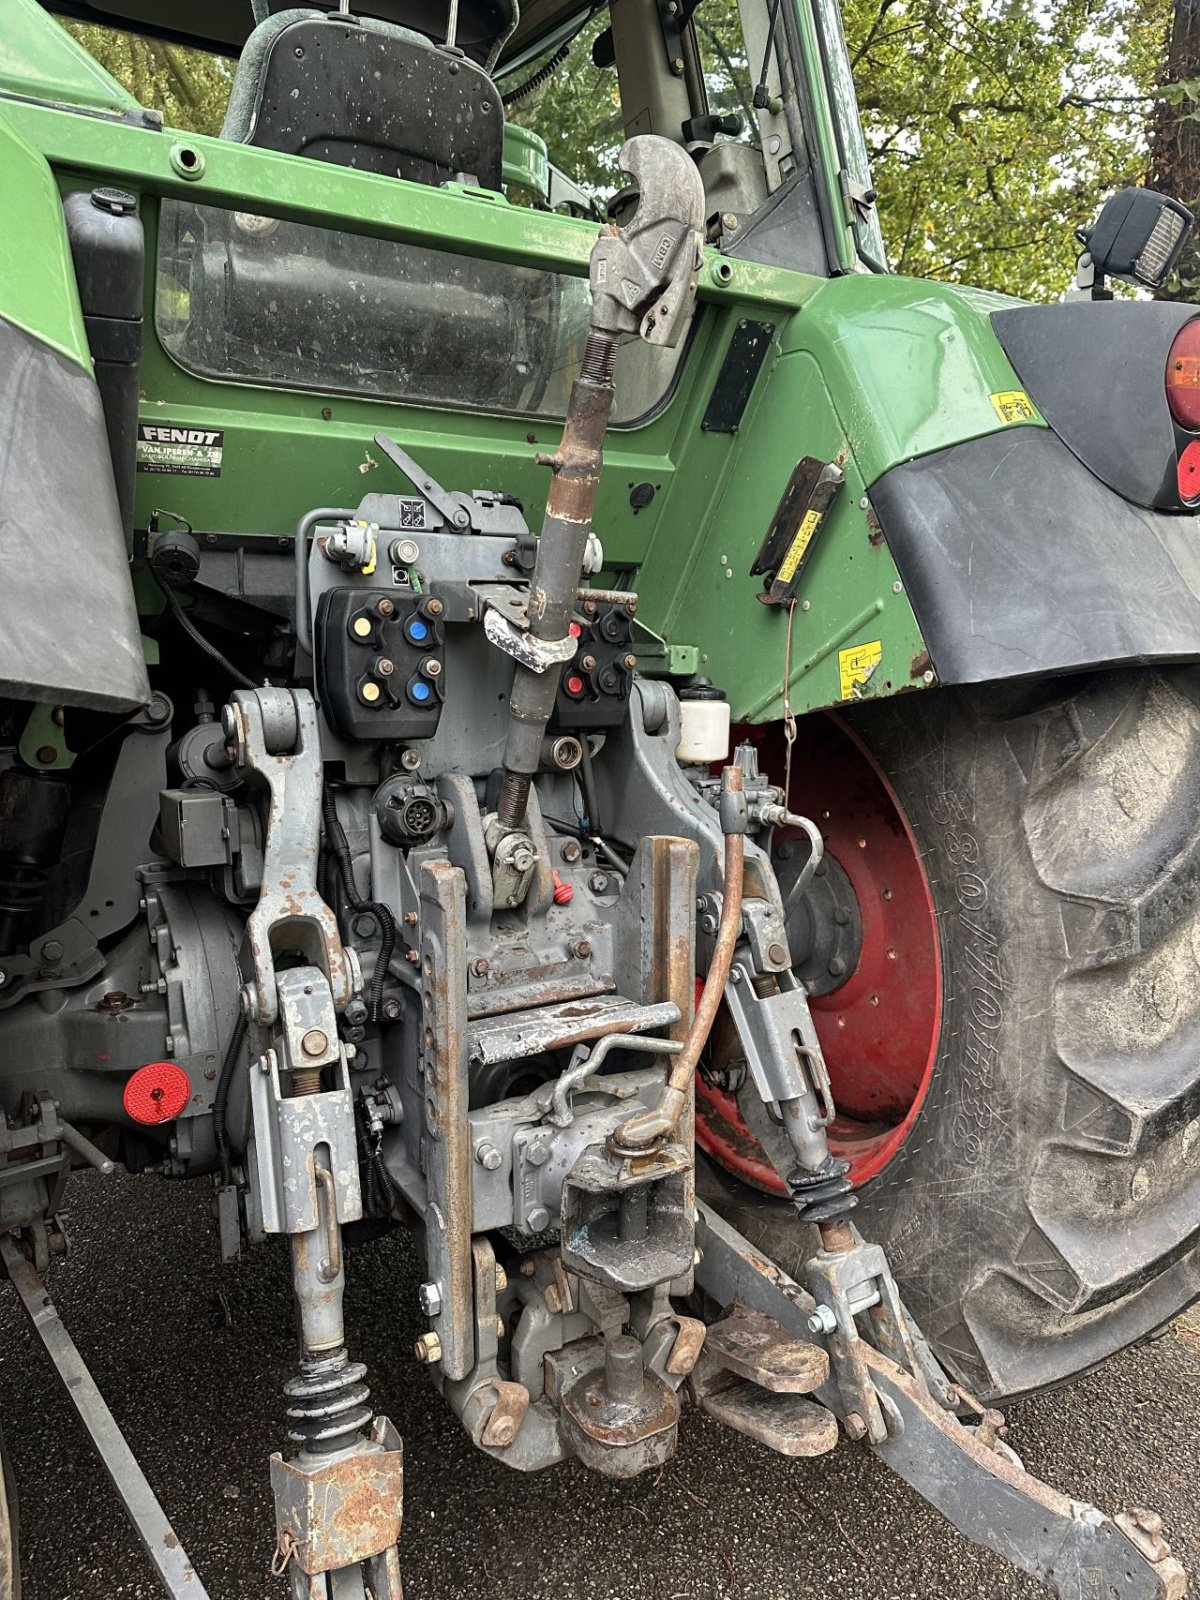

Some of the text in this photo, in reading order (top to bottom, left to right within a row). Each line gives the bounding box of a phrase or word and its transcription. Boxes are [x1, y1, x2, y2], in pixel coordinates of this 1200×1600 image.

[142, 427, 220, 445] FENDT
[142, 446, 161, 454] VAN
[163, 447, 193, 457] IPEREN
